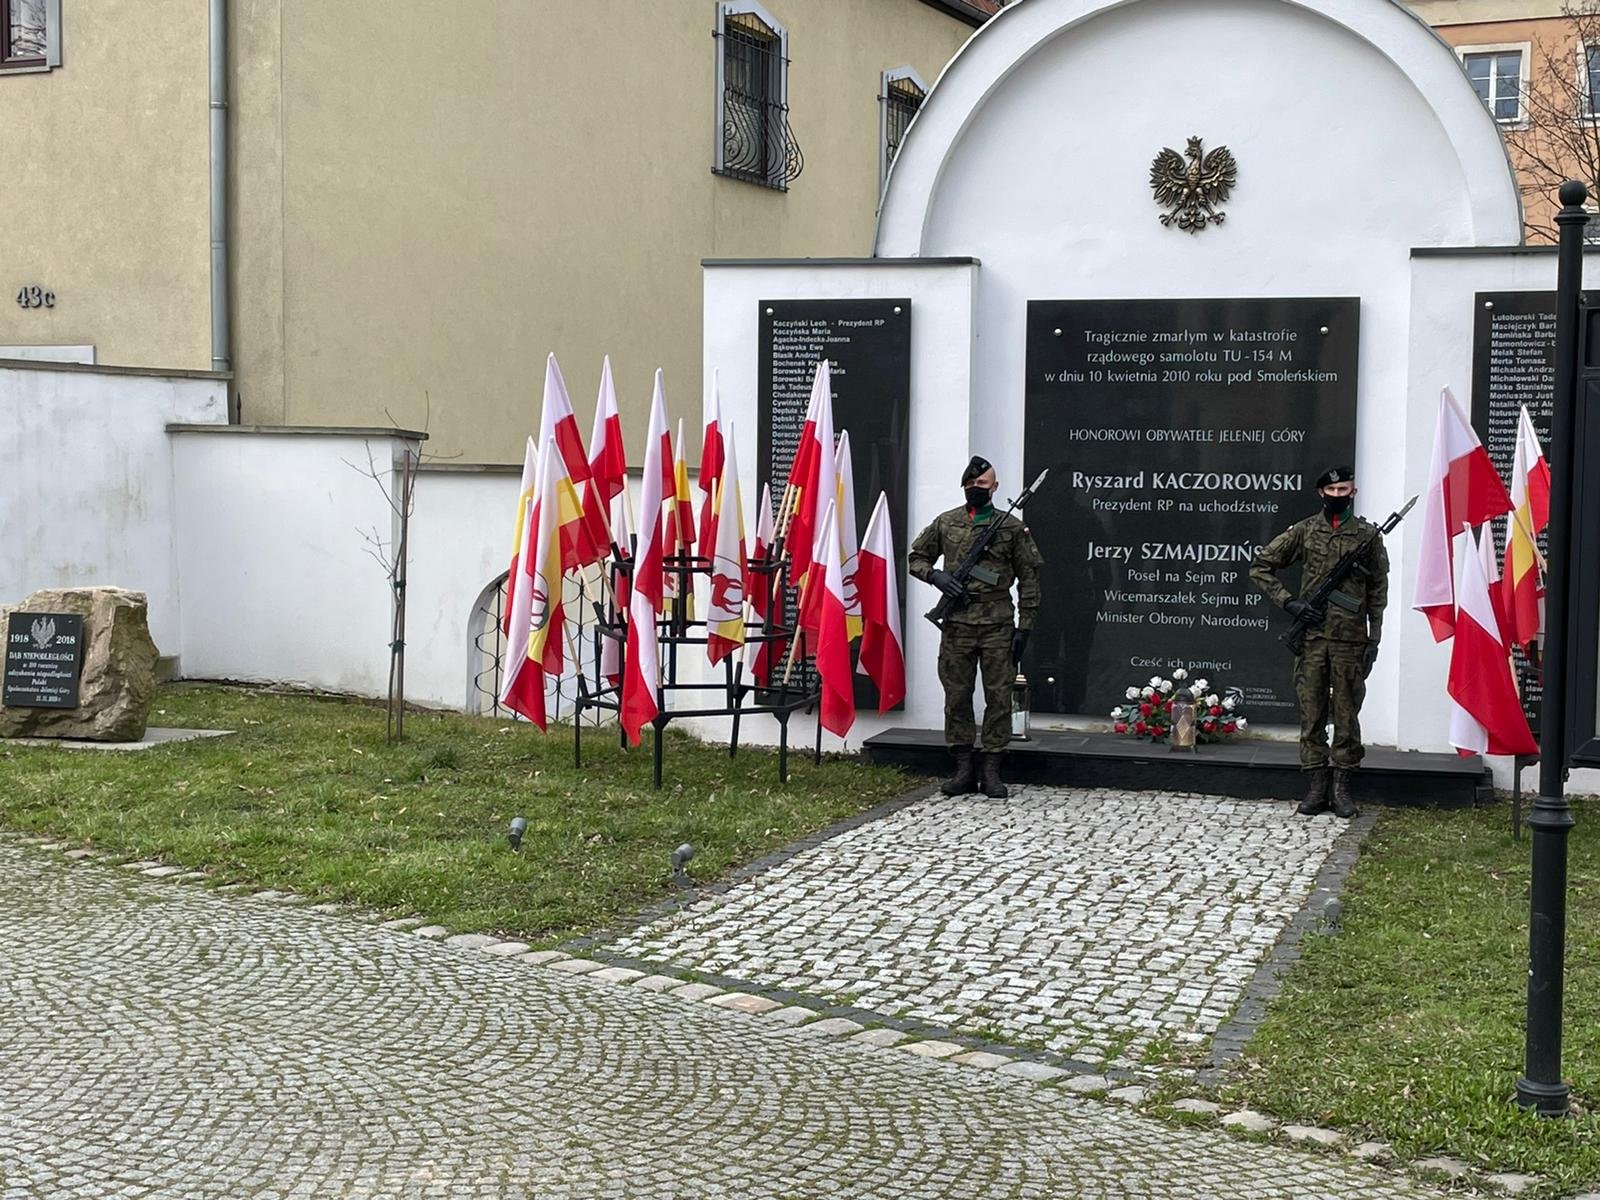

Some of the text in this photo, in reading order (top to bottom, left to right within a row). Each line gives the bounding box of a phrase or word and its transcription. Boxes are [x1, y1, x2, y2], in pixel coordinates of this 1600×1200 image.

[16, 286, 56, 309] 43c
[838, 320, 873, 328] Prezydent
[1492, 313, 1535, 321] Lutoborski
[1492, 322, 1536, 331] Maciejczyk
[1085, 329, 1297, 346] Tragicznie zmarłym w katastrofie
[795, 352, 820, 360] Andrzej
[1087, 350, 1155, 366] rządowego
[1160, 350, 1217, 362] samolotu
[1280, 350, 1292, 361] M
[1045, 369, 1338, 385] w dniu 10 kwietnia 2010 roku pod Smoleńskiem
[1070, 428, 1306, 443] HONOROWI OBYWATELE JELENIEJ GÓRY
[1072, 471, 1302, 493] Ryszard KACZOROWSKI
[1092, 499, 1279, 514] Prezydent RP na uchodźstwie
[1087, 540, 1264, 564] Jerzy SZMAJDZIŃS
[1128, 569, 1238, 586] Poseł na Sejm RP
[1104, 590, 1262, 608] Wicemarszałek Sejmu RP
[1096, 611, 1269, 631] Minister Obrony Narodowej
[10, 634, 76, 644] 1918 2018
[1130, 656, 1232, 672] Cześć ich pamięci
